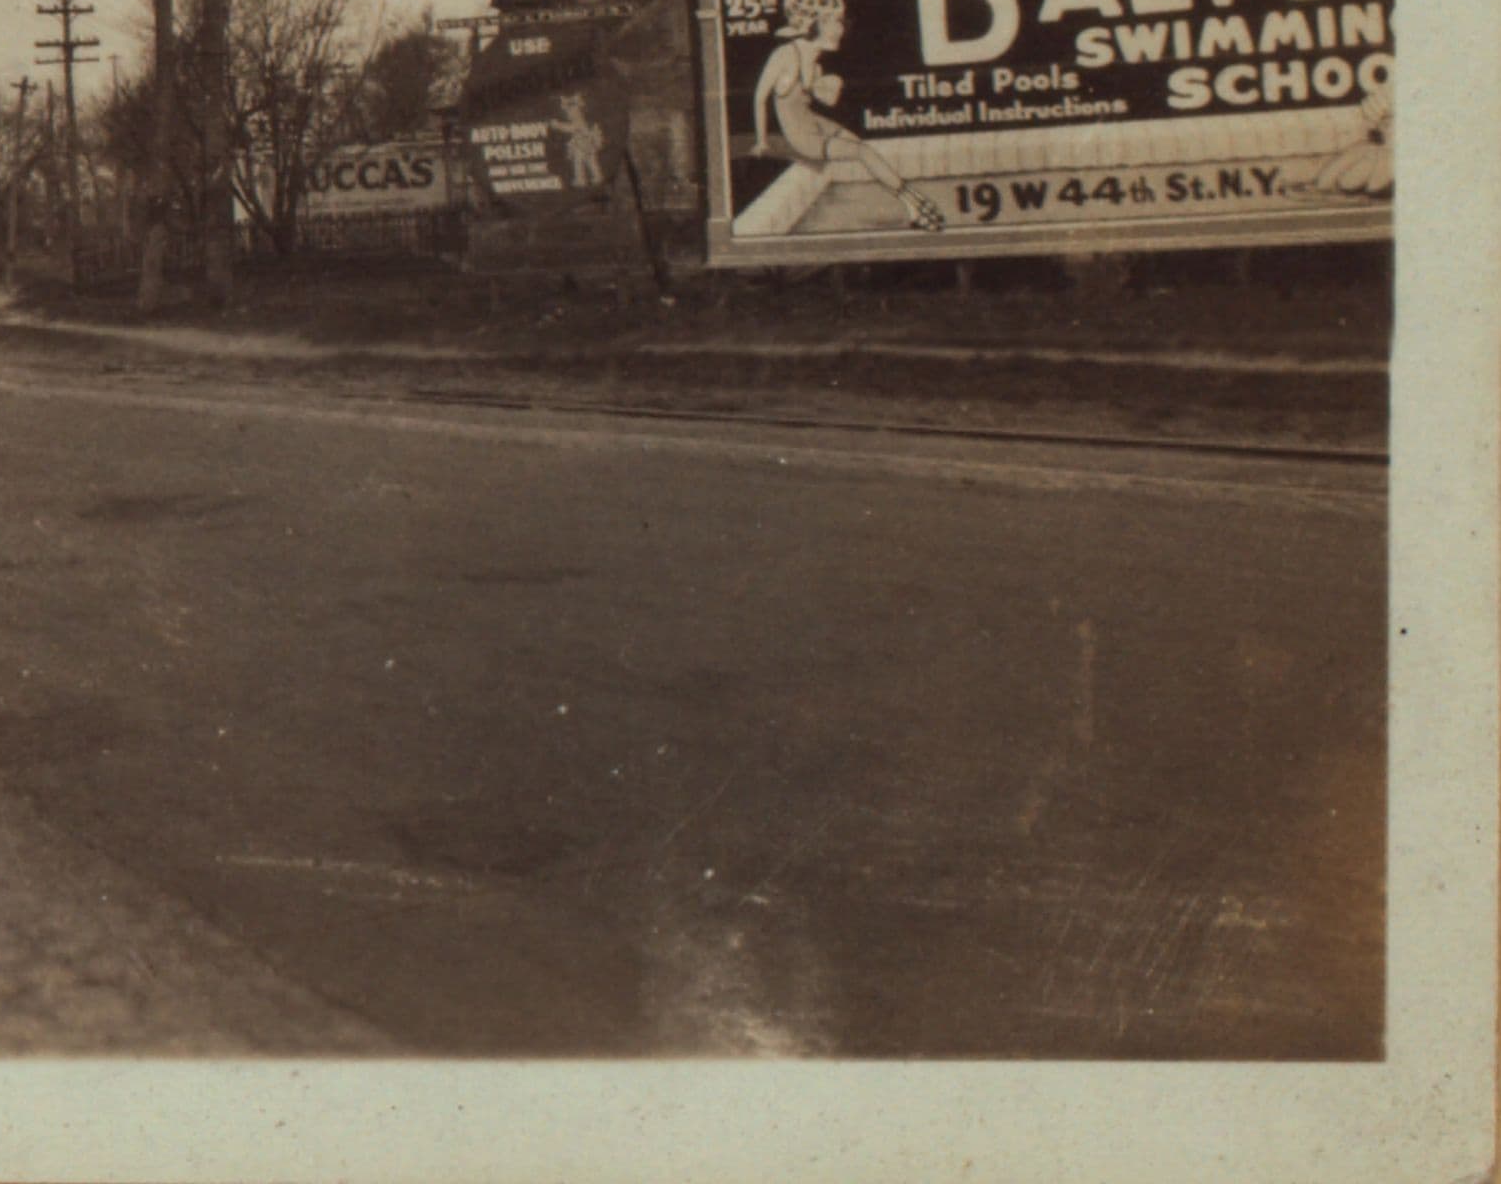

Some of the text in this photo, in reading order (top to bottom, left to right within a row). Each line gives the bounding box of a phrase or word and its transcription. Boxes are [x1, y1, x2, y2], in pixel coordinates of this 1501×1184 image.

[726, 19, 769, 37] YEAR
[1076, 2, 1396, 68] SWIMMIN
[510, 37, 551, 57] USE
[899, 64, 1081, 99] Tiled Pools
[864, 96, 1129, 130] Individual Instructions
[483, 142, 546, 160] POLISH
[956, 182, 1002, 222] 19
[1010, 179, 1048, 211] W
[1057, 175, 1156, 207] 44th
